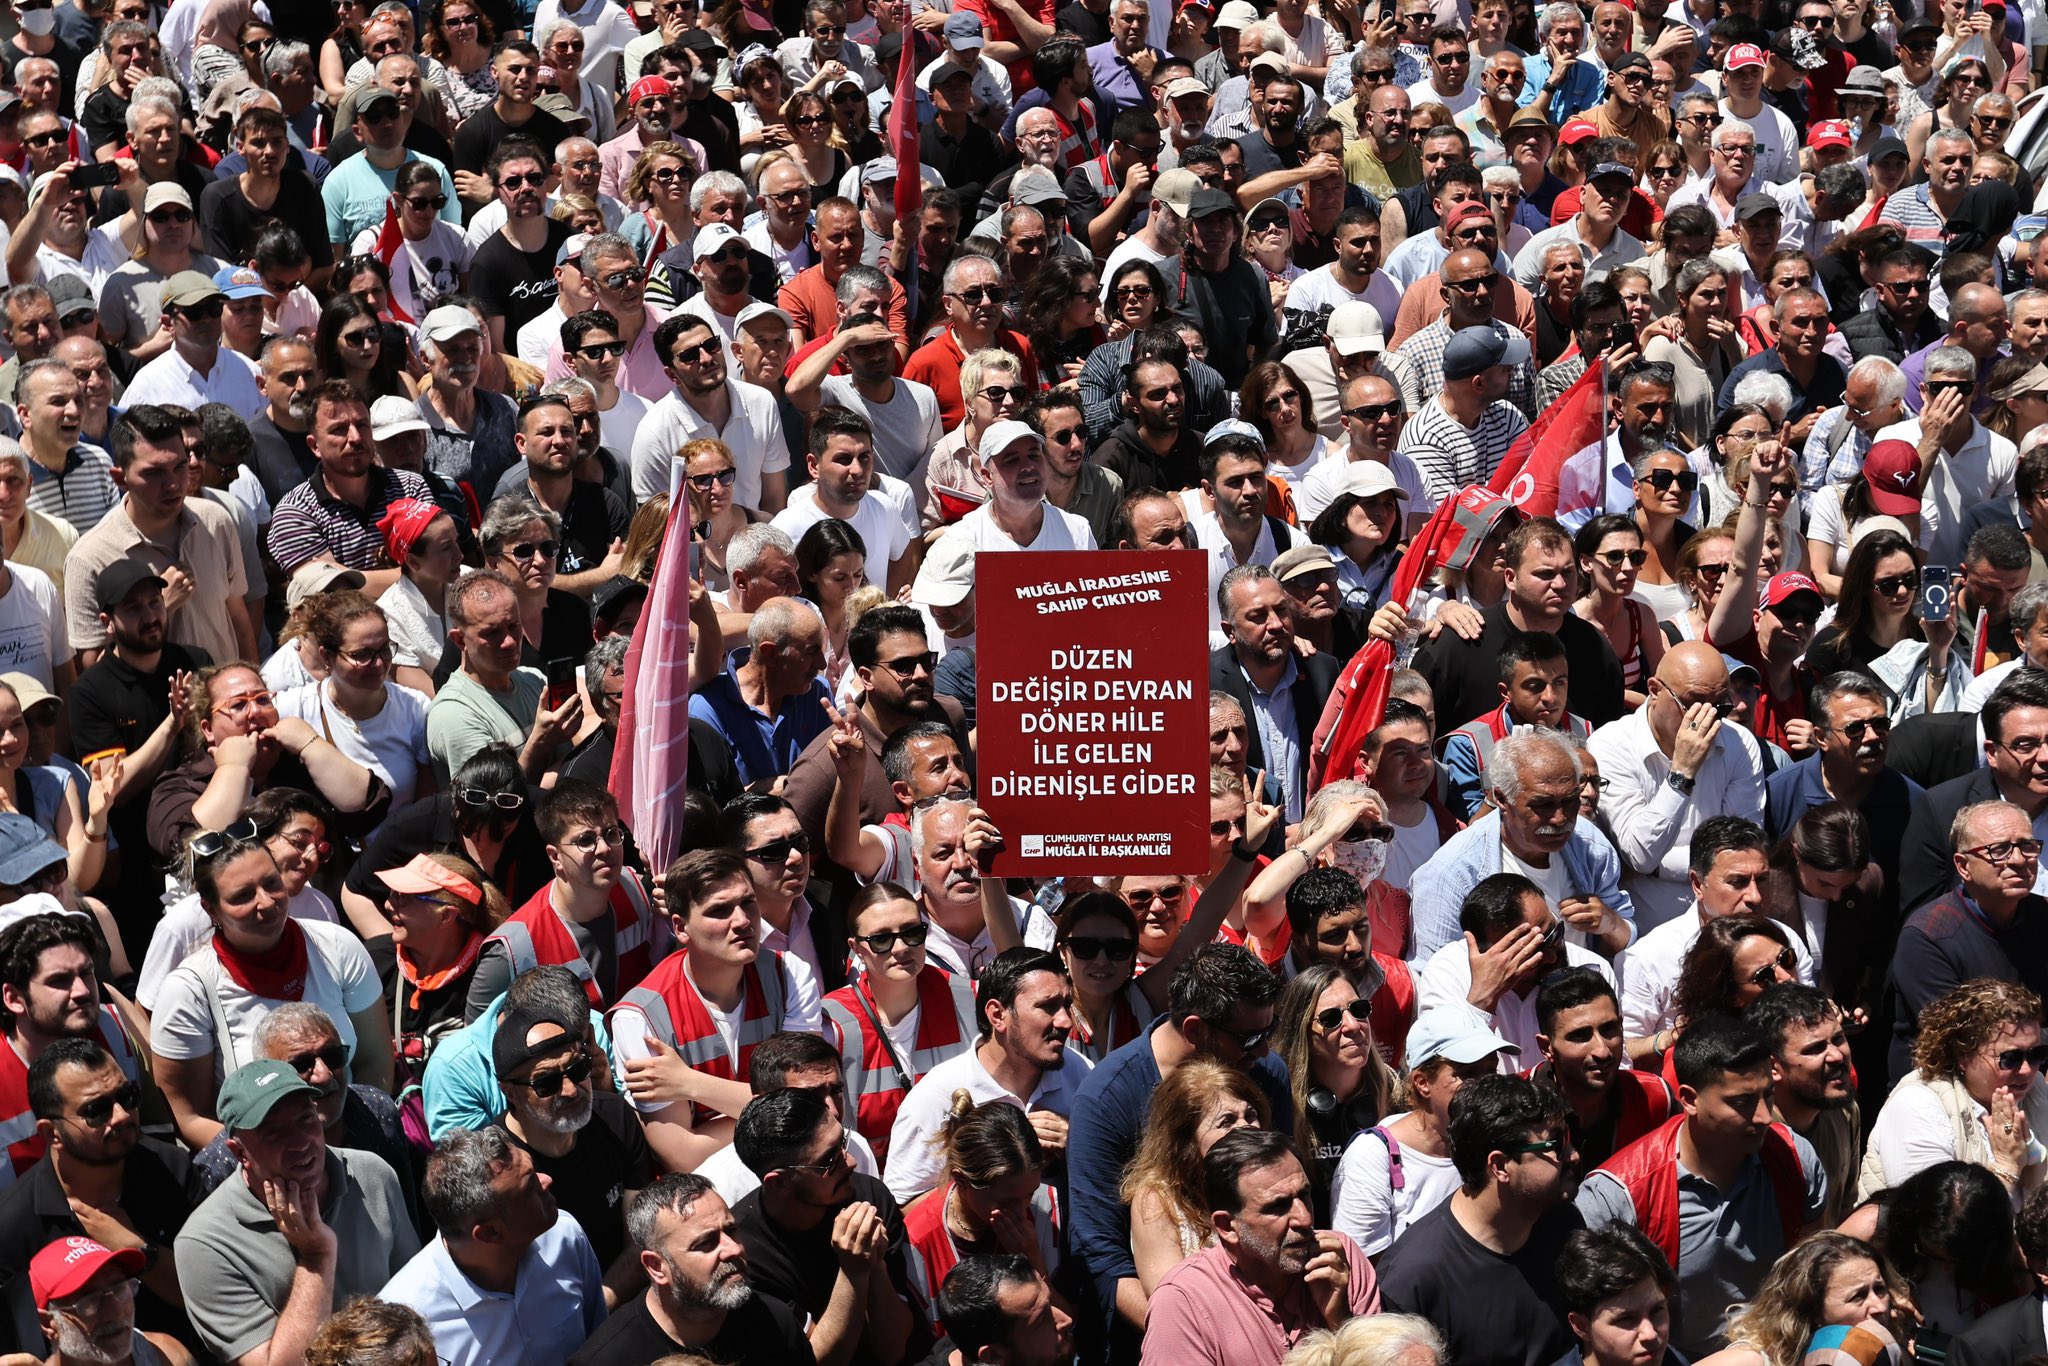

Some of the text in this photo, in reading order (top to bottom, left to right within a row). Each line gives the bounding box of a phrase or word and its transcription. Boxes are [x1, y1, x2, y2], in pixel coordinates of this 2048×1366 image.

[1016, 570, 1171, 600] MUĞLA İRADESİNE
[1036, 589, 1162, 615] SAHİP ÇIKIYOR
[1051, 644, 1133, 670] DÜZEN
[992, 675, 1192, 707] DEĞİŞİR DEVRAN
[1021, 706, 1165, 733] DÖNER HİLE
[1034, 738, 1152, 765] İLE GELEN
[991, 768, 1196, 801] DİRENİŞLE GİDER
[1045, 842, 1171, 858] MUĞLA İL BAŞKANLIĞI
[1108, 833, 1134, 842] HALK
